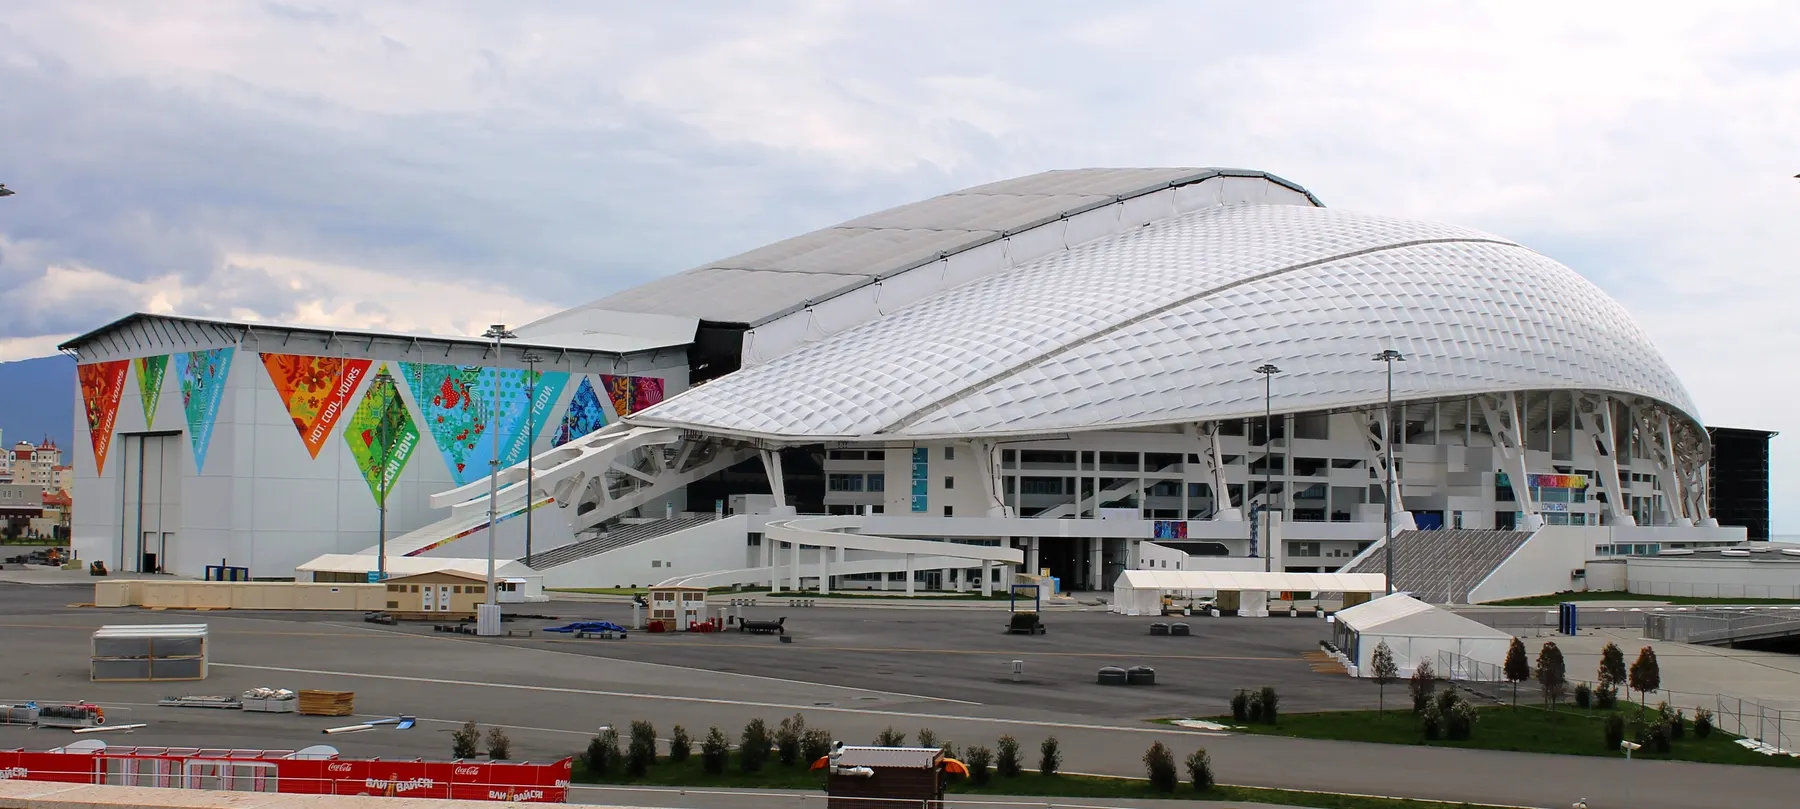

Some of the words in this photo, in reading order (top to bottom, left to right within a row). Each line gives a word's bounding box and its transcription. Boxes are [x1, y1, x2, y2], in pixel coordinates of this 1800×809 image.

[98, 434, 107, 457] HOT.
[104, 407, 115, 433] COOL.
[112, 369, 124, 403] YOURS.
[309, 423, 327, 444] HOT.
[321, 400, 342, 423] COOL.
[336, 367, 362, 398] YOURS.
[506, 418, 537, 464] ЗИМНИЕ.
[532, 385, 555, 416] ТВОИ.
[394, 432, 416, 461] 2014
